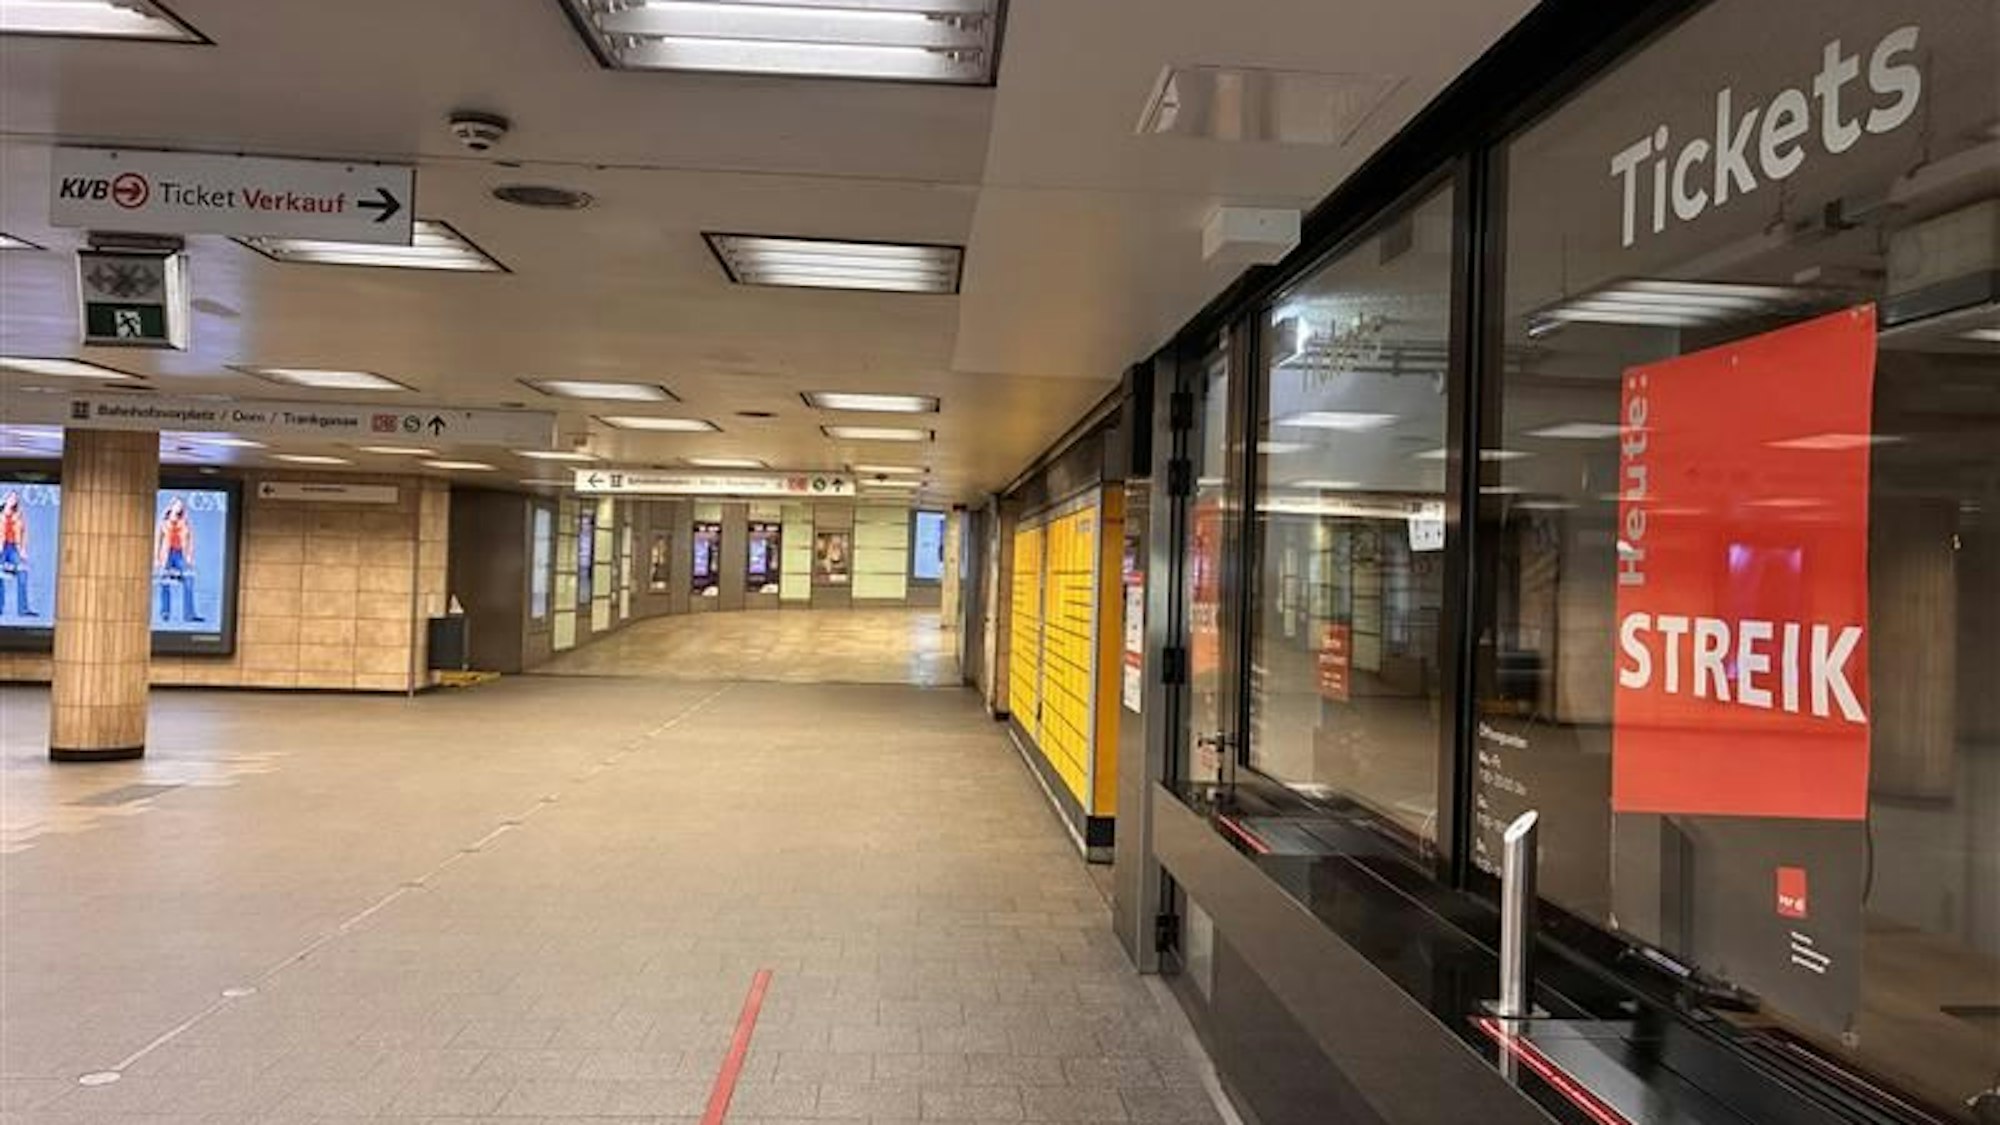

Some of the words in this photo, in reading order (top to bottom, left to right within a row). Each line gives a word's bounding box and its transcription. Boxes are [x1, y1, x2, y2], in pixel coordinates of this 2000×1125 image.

[60, 177, 109, 201] KVB
[160, 182, 235, 208] Ticket
[242, 187, 345, 214] Verkauf
[1610, 26, 1921, 248] Tickets
[1615, 373, 1648, 586] Heute:
[1619, 611, 1868, 725] STREIK
